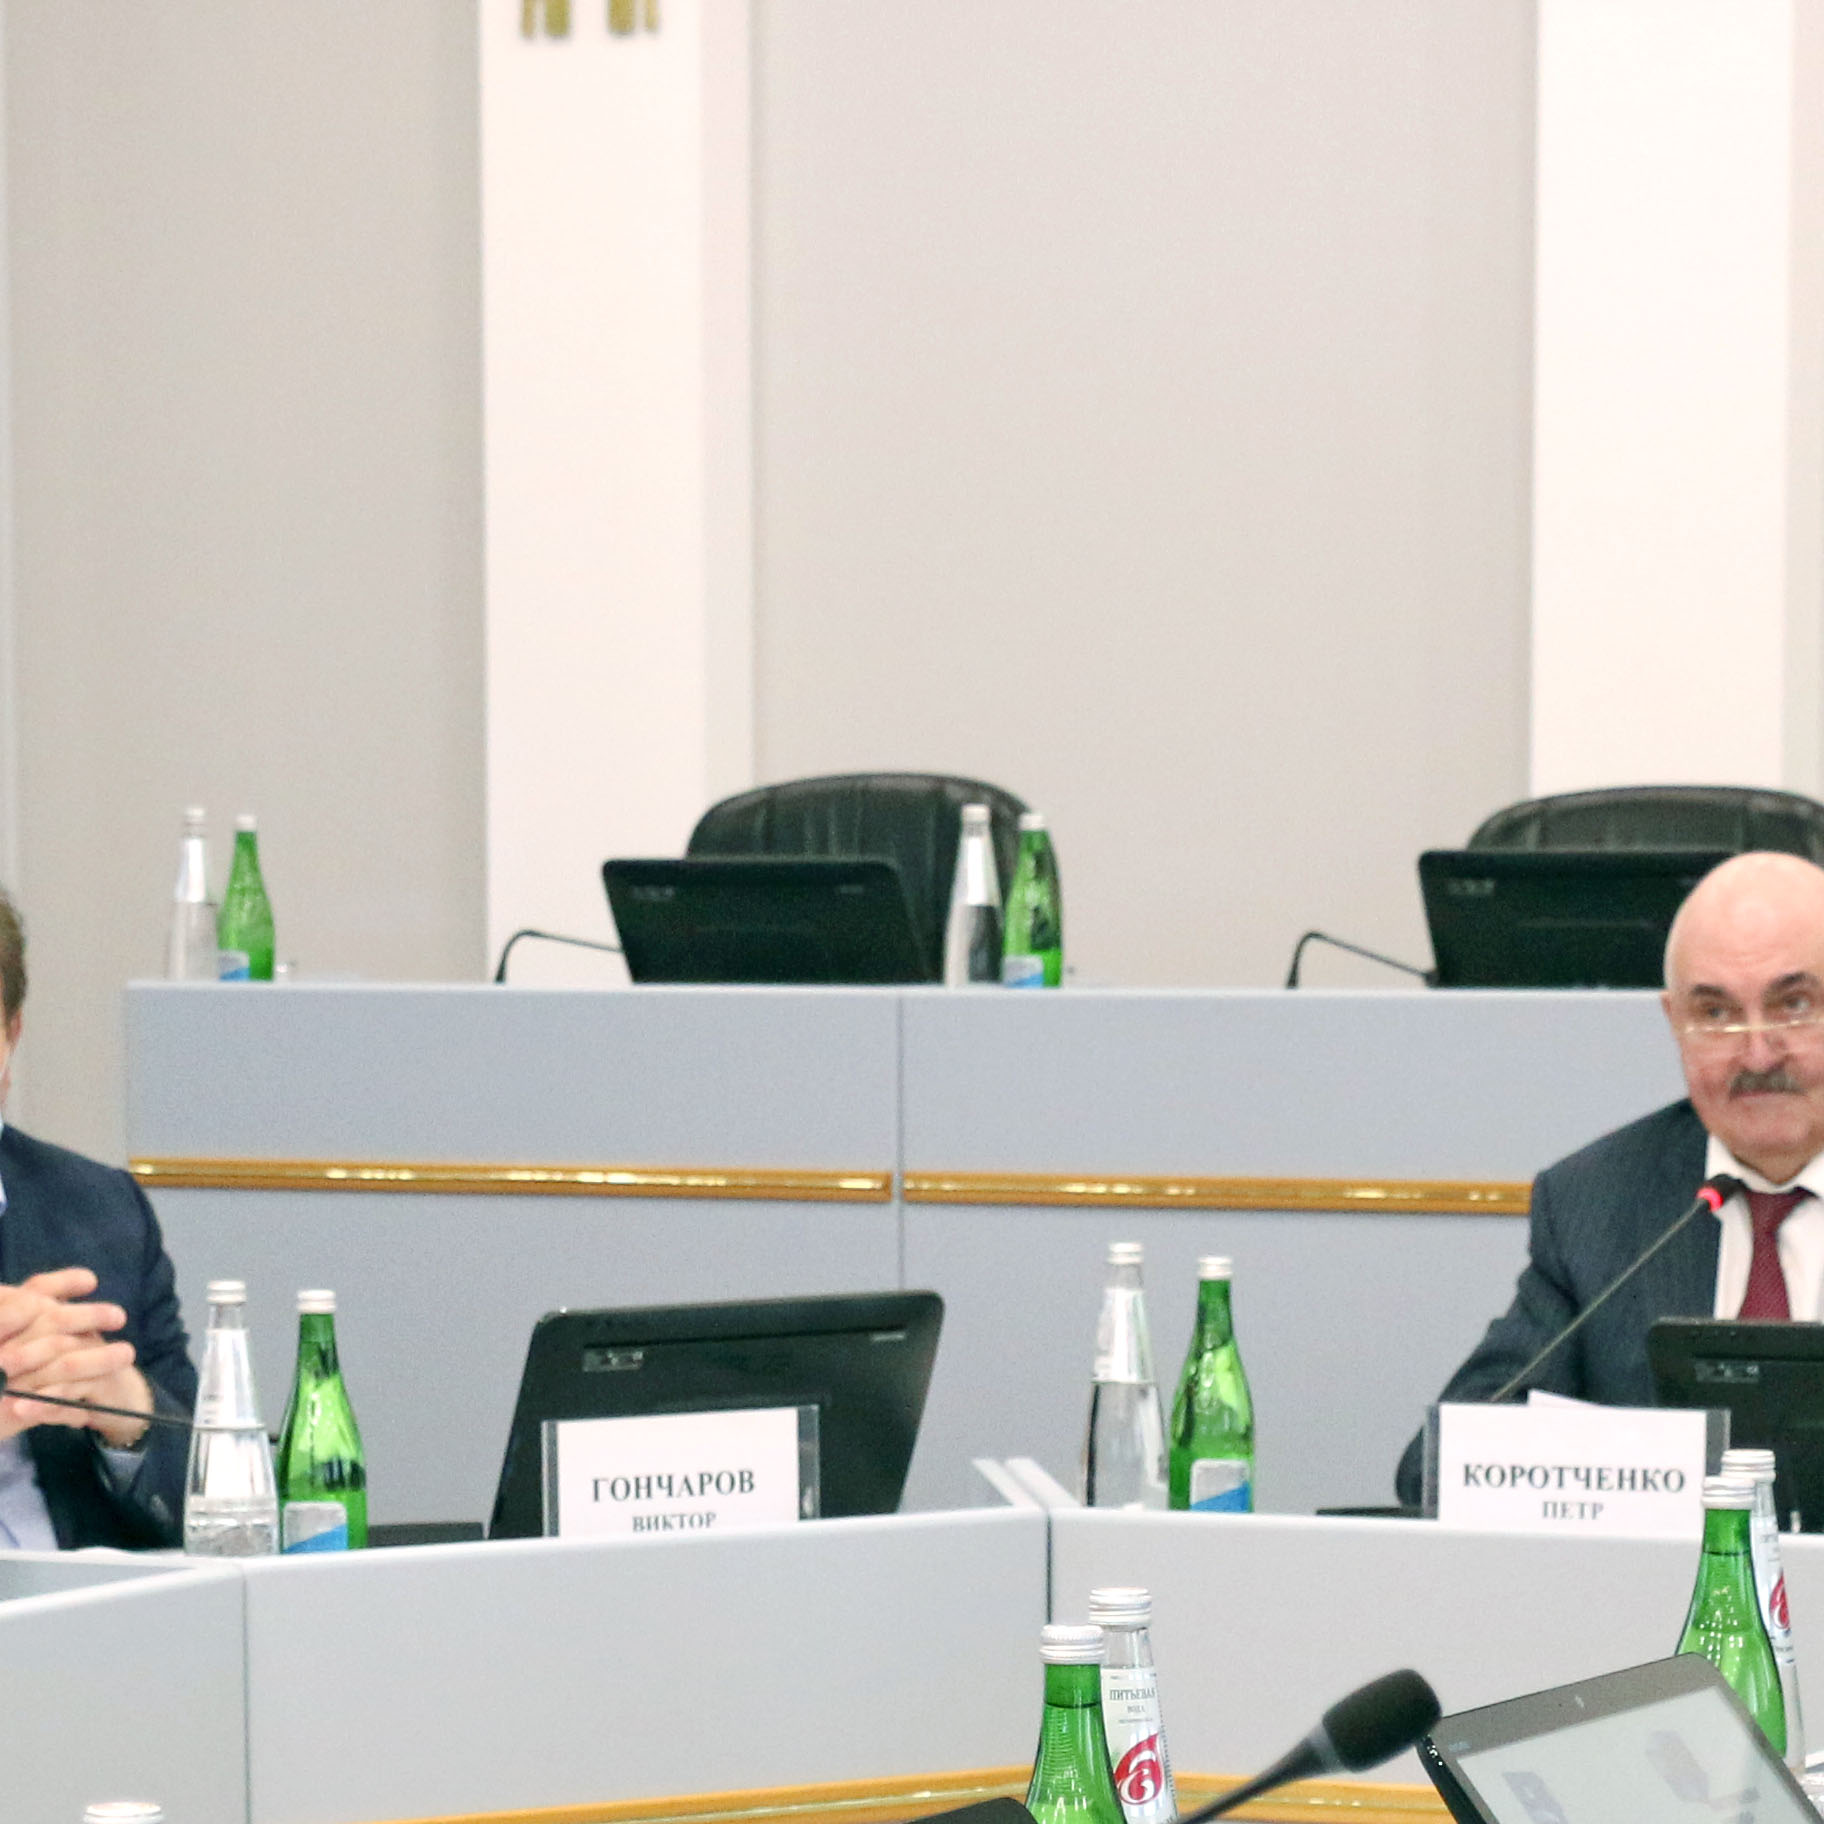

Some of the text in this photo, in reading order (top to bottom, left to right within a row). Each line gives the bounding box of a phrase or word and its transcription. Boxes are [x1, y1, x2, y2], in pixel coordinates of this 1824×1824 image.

[591, 1469, 755, 1502] ГОНЧАРОВ
[1462, 1463, 1686, 1494] КОРОТЧЕНКО
[631, 1511, 717, 1533] ВИКТОР
[1541, 1500, 1605, 1520] ПЕТР
